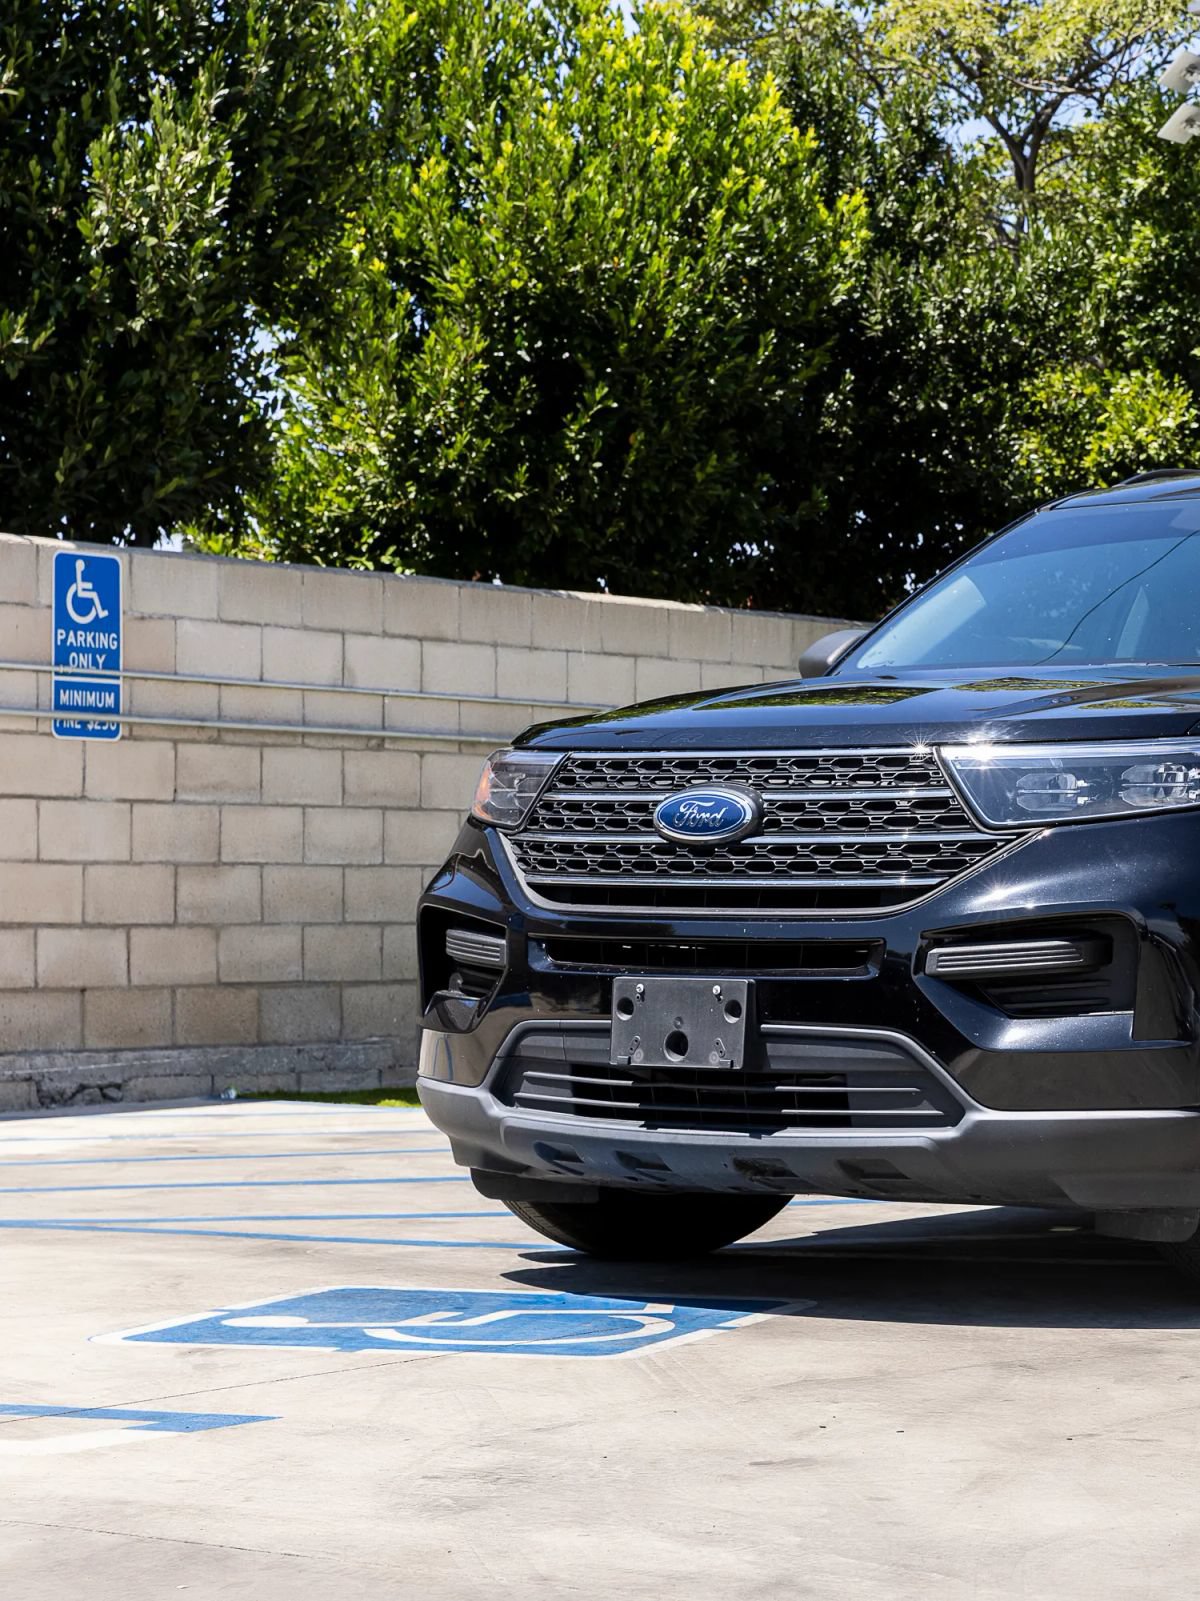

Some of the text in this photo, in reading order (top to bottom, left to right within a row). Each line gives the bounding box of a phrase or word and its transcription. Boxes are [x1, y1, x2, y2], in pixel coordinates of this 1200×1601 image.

[57, 628, 118, 650] PARKING
[69, 652, 107, 670] ONLY
[60, 688, 115, 709] MINIMUM
[673, 800, 729, 828] Ford
